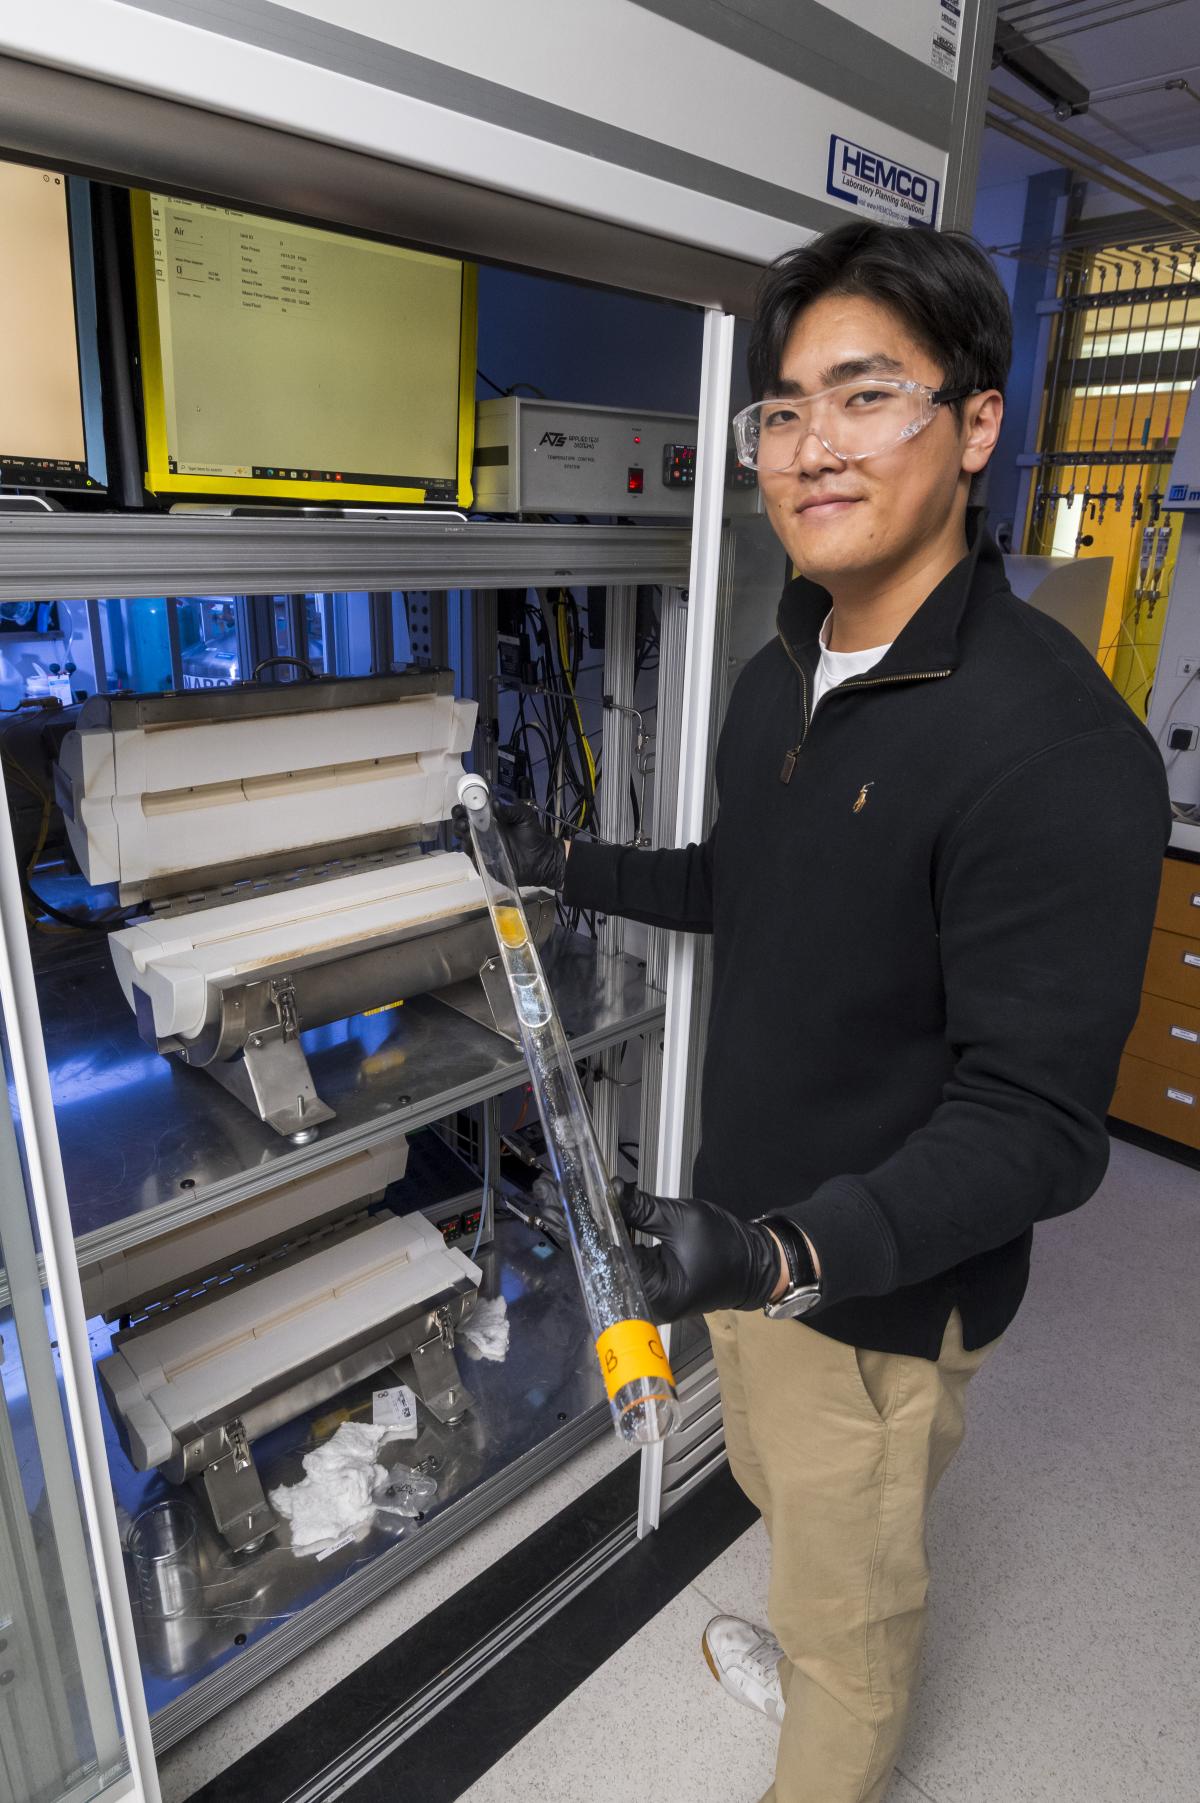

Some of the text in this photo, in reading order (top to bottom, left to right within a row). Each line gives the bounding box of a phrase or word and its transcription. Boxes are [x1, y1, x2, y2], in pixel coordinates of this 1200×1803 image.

[842, 145, 928, 203] HEMCO
[842, 175, 925, 216] Laboratory Planning Solutions
[174, 227, 184, 236] Air
[539, 431, 567, 447] ATS
[605, 1339, 664, 1374] B C
